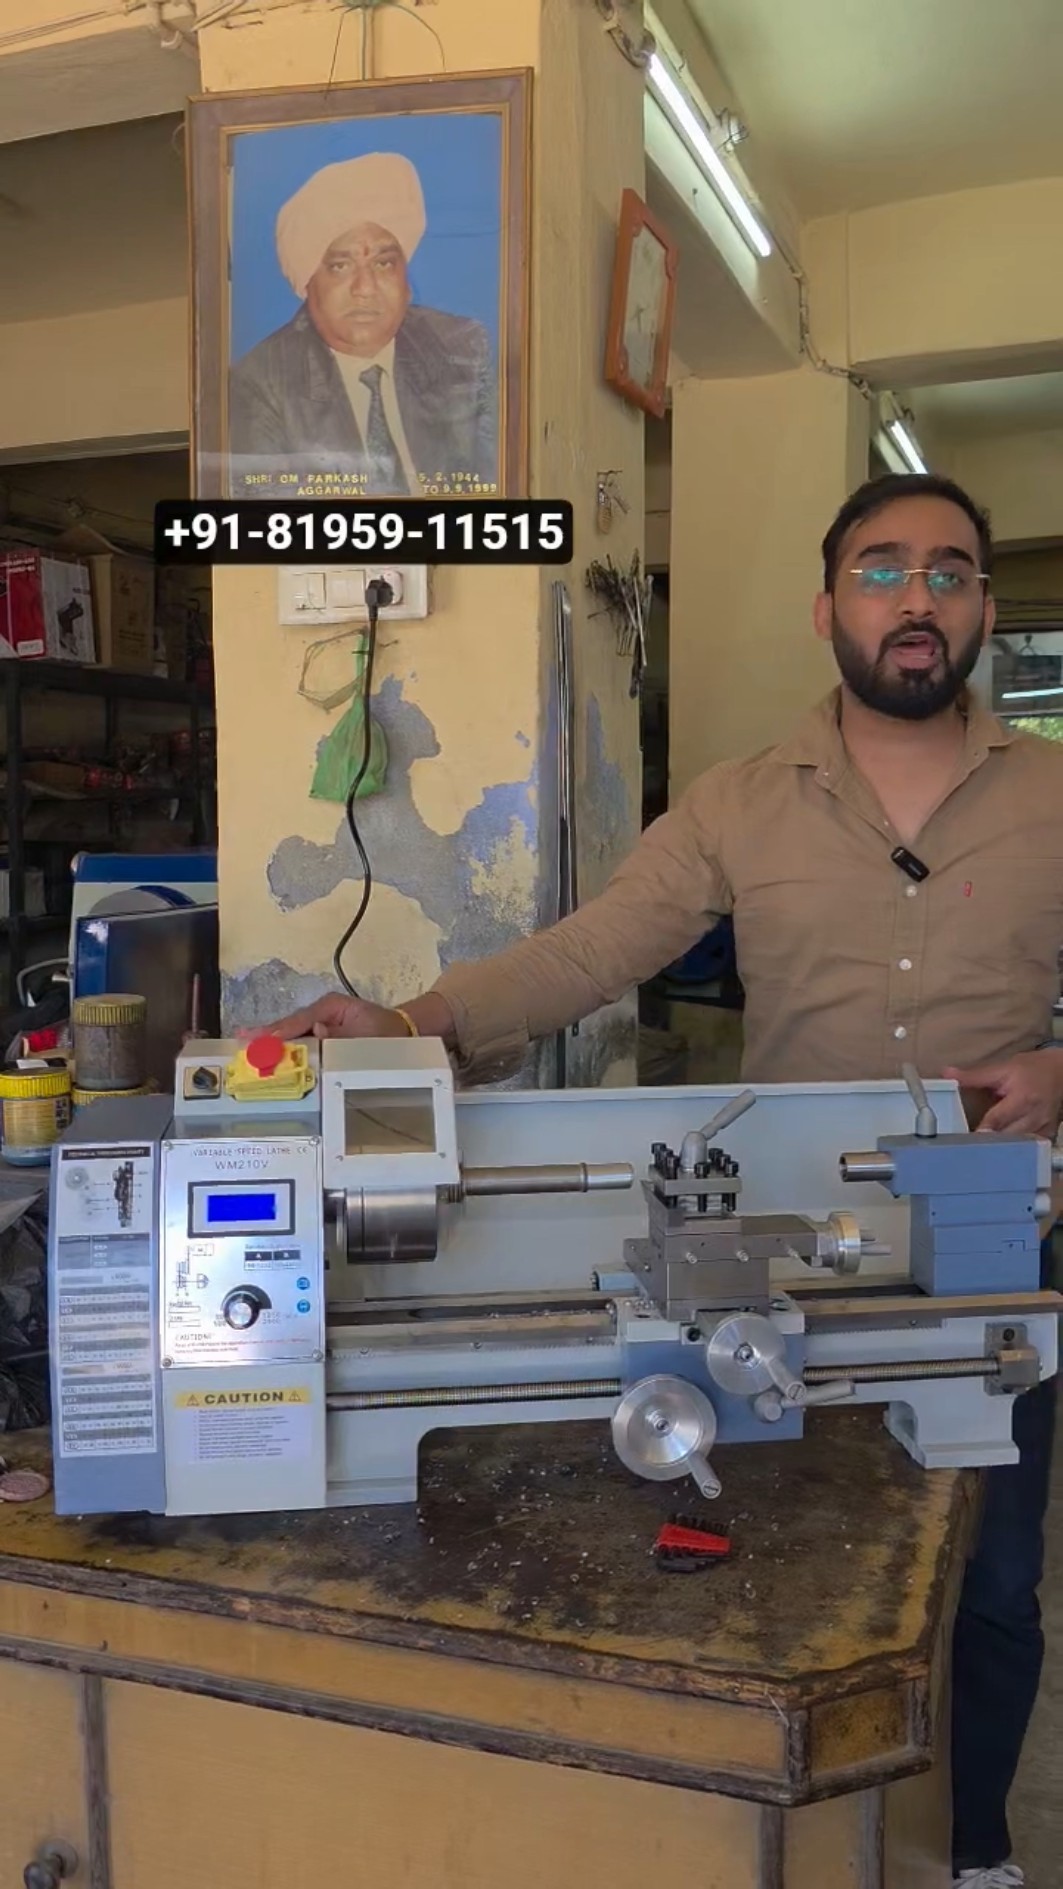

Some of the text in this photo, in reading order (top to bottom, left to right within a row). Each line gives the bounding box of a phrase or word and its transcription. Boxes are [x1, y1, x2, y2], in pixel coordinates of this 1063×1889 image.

[280, 474, 299, 484] OM
[307, 474, 368, 484] PARKASH
[297, 486, 367, 496] AGGARWAL
[423, 485, 439, 494] TO
[215, 1159, 269, 1170] WM210V
[204, 1391, 284, 1405] CAUTION
